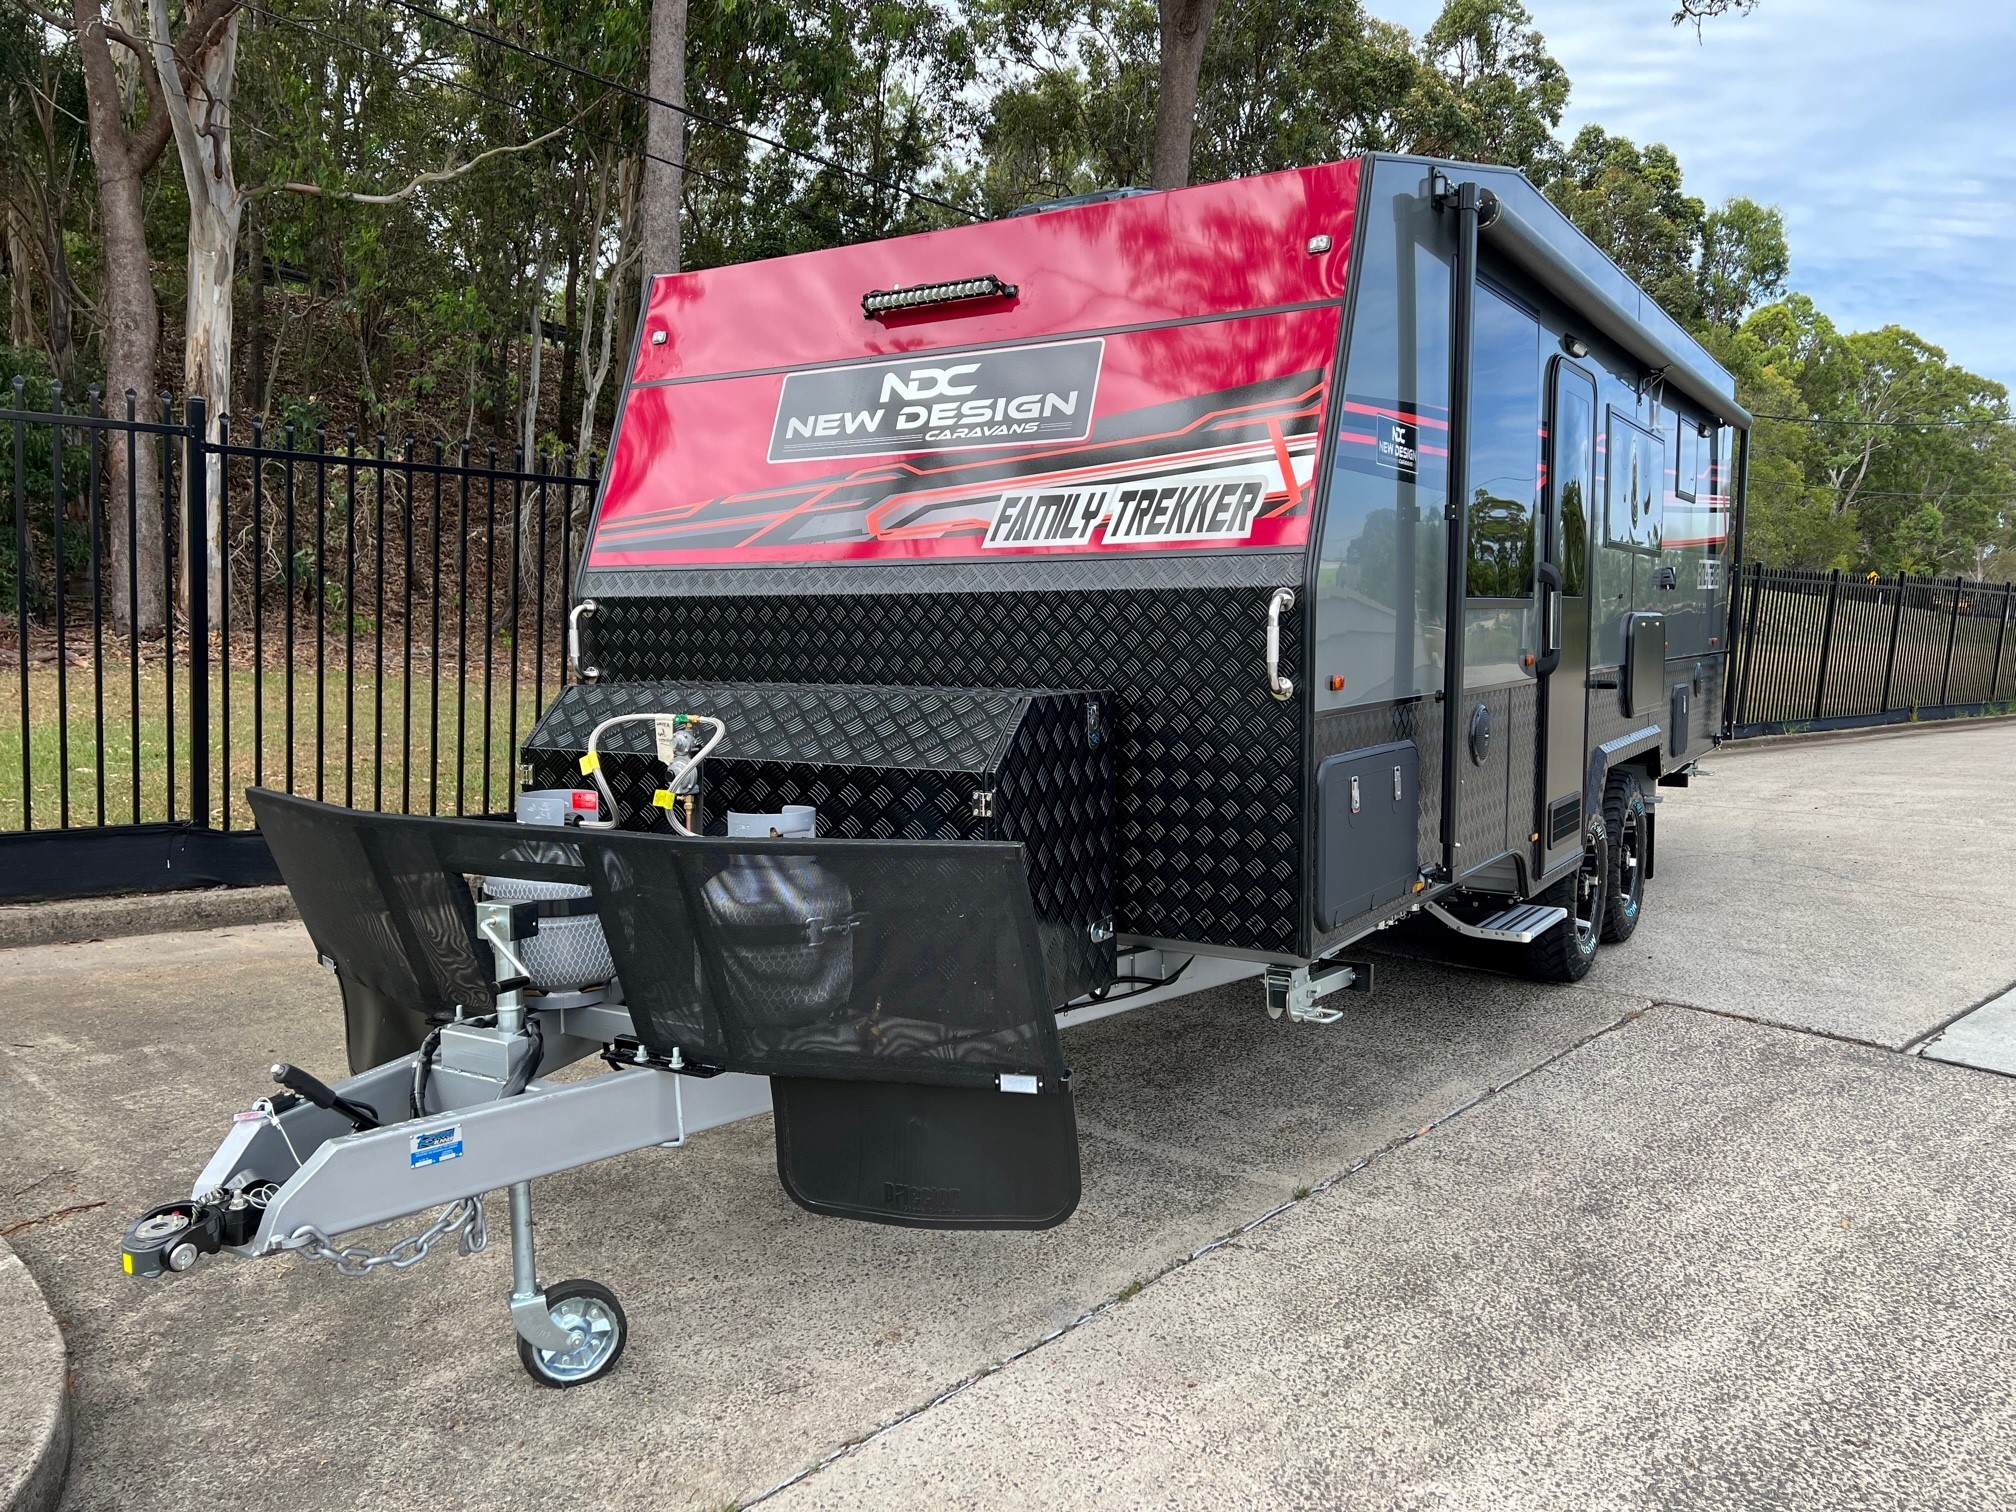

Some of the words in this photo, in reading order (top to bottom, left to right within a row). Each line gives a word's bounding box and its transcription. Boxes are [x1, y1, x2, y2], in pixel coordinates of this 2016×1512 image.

[880, 363, 982, 403] NDC
[785, 408, 887, 439] NEW
[895, 390, 1079, 430] DESIGN
[924, 421, 1040, 442] CARAVANS
[1392, 425, 1406, 444] NDC
[1379, 440, 1394, 455] NEW
[1394, 444, 1417, 462] DESIGN
[990, 491, 1108, 542] FAMILY
[1111, 482, 1264, 538] TREKKER
